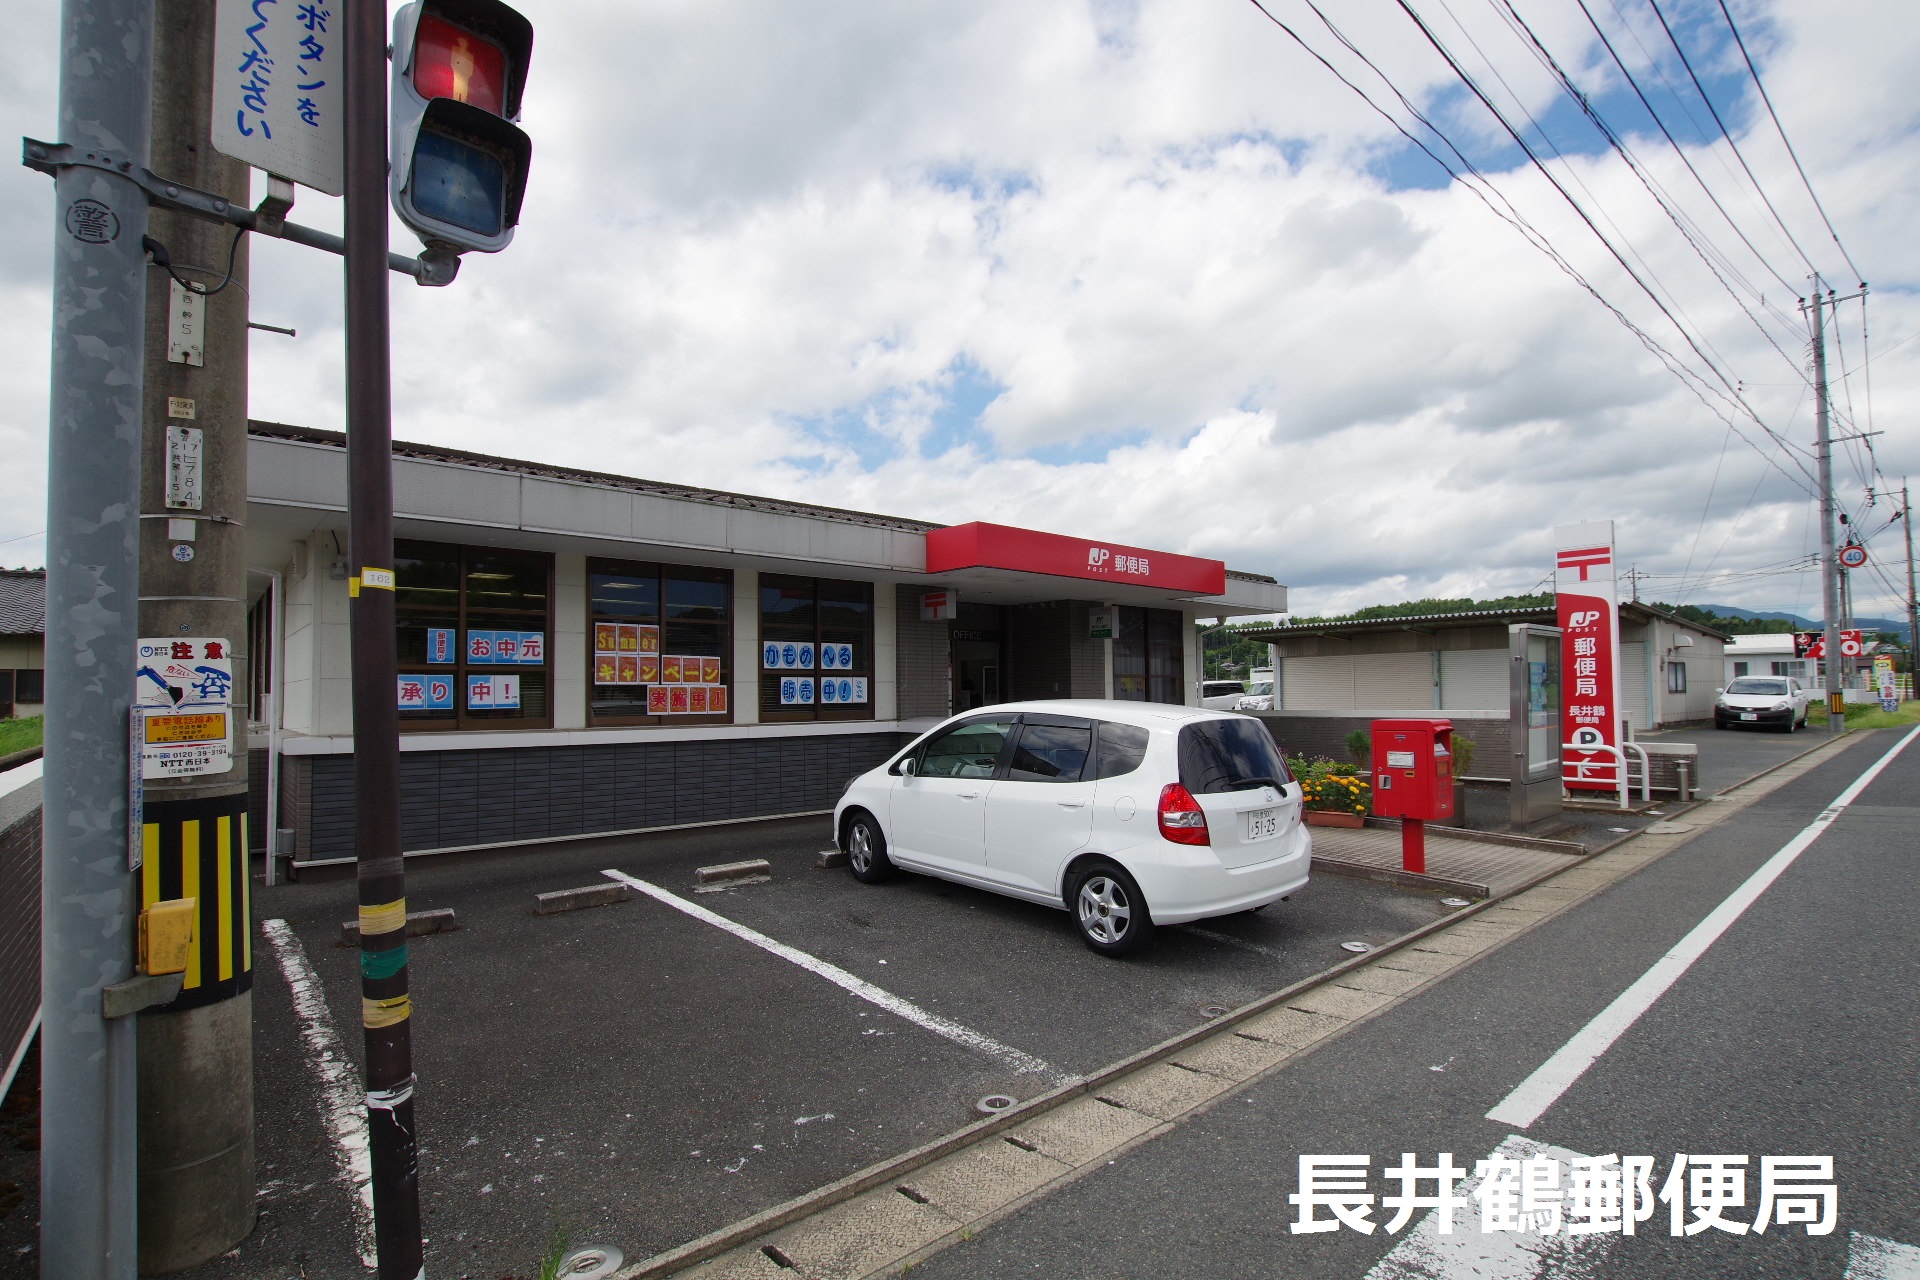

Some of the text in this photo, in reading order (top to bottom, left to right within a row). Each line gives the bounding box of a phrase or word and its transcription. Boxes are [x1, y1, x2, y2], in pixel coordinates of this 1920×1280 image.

[296, 0, 331, 127] ボタンを
[1114, 554, 1150, 576] 郵便局
[1845, 551, 1863, 563] 40
[1568, 610, 1600, 627] JP
[598, 631, 657, 650] Summer
[953, 629, 982, 641] OFFICE
[171, 641, 223, 660] 注意
[470, 638, 541, 657] お中元
[597, 662, 720, 681] キャンペーン
[1573, 637, 1598, 697] 郵便局
[1569, 705, 1606, 717] 長井鶴
[1575, 716, 1600, 724] 郵便局
[152, 715, 221, 727] 重要電話線あり
[160, 757, 211, 768] NTT 西日本
